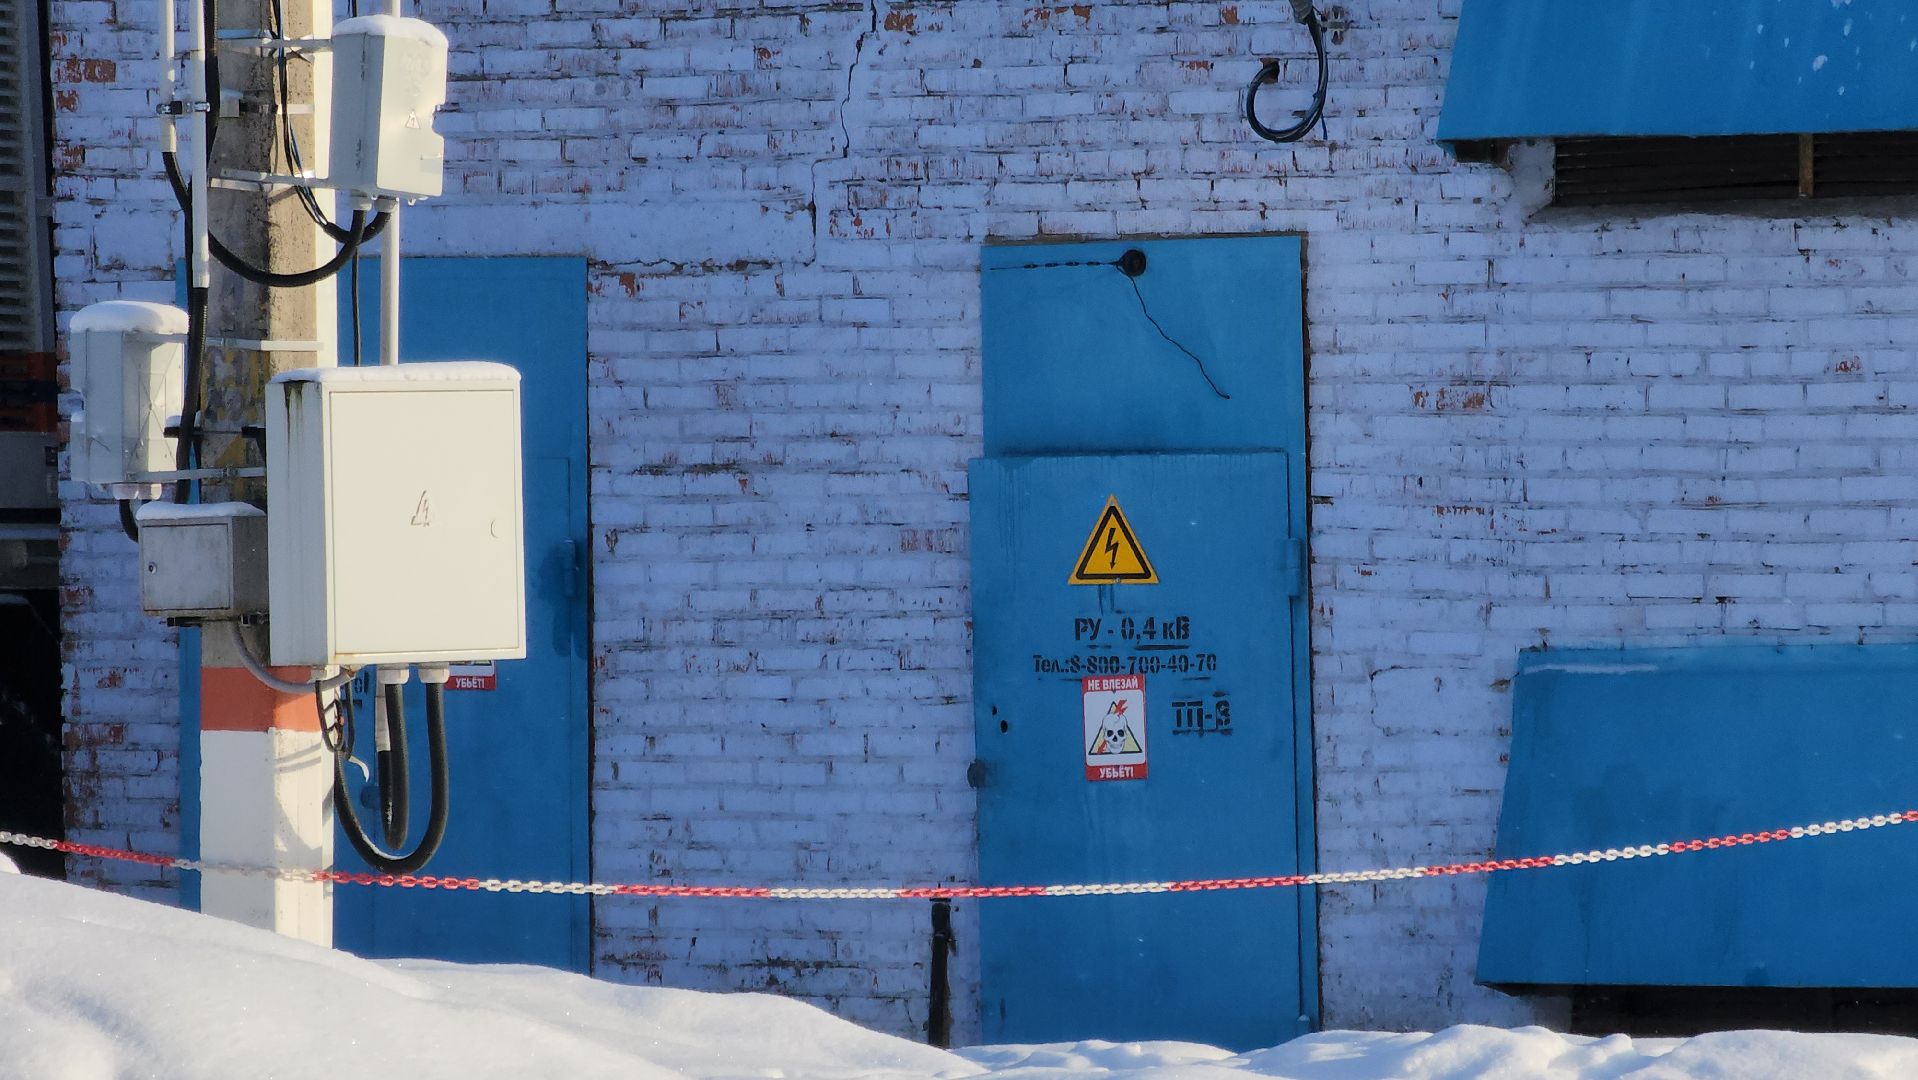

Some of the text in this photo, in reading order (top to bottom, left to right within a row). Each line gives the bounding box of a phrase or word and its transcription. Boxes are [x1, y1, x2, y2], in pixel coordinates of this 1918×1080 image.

[1074, 617, 1101, 641] РУ
[1162, 615, 1190, 640] кВ
[455, 676, 485, 689] УБЬЁТ!
[1087, 676, 1139, 691] НЕ ВЛЕЗАЙ
[1099, 764, 1134, 779] УБЬЁТ!
